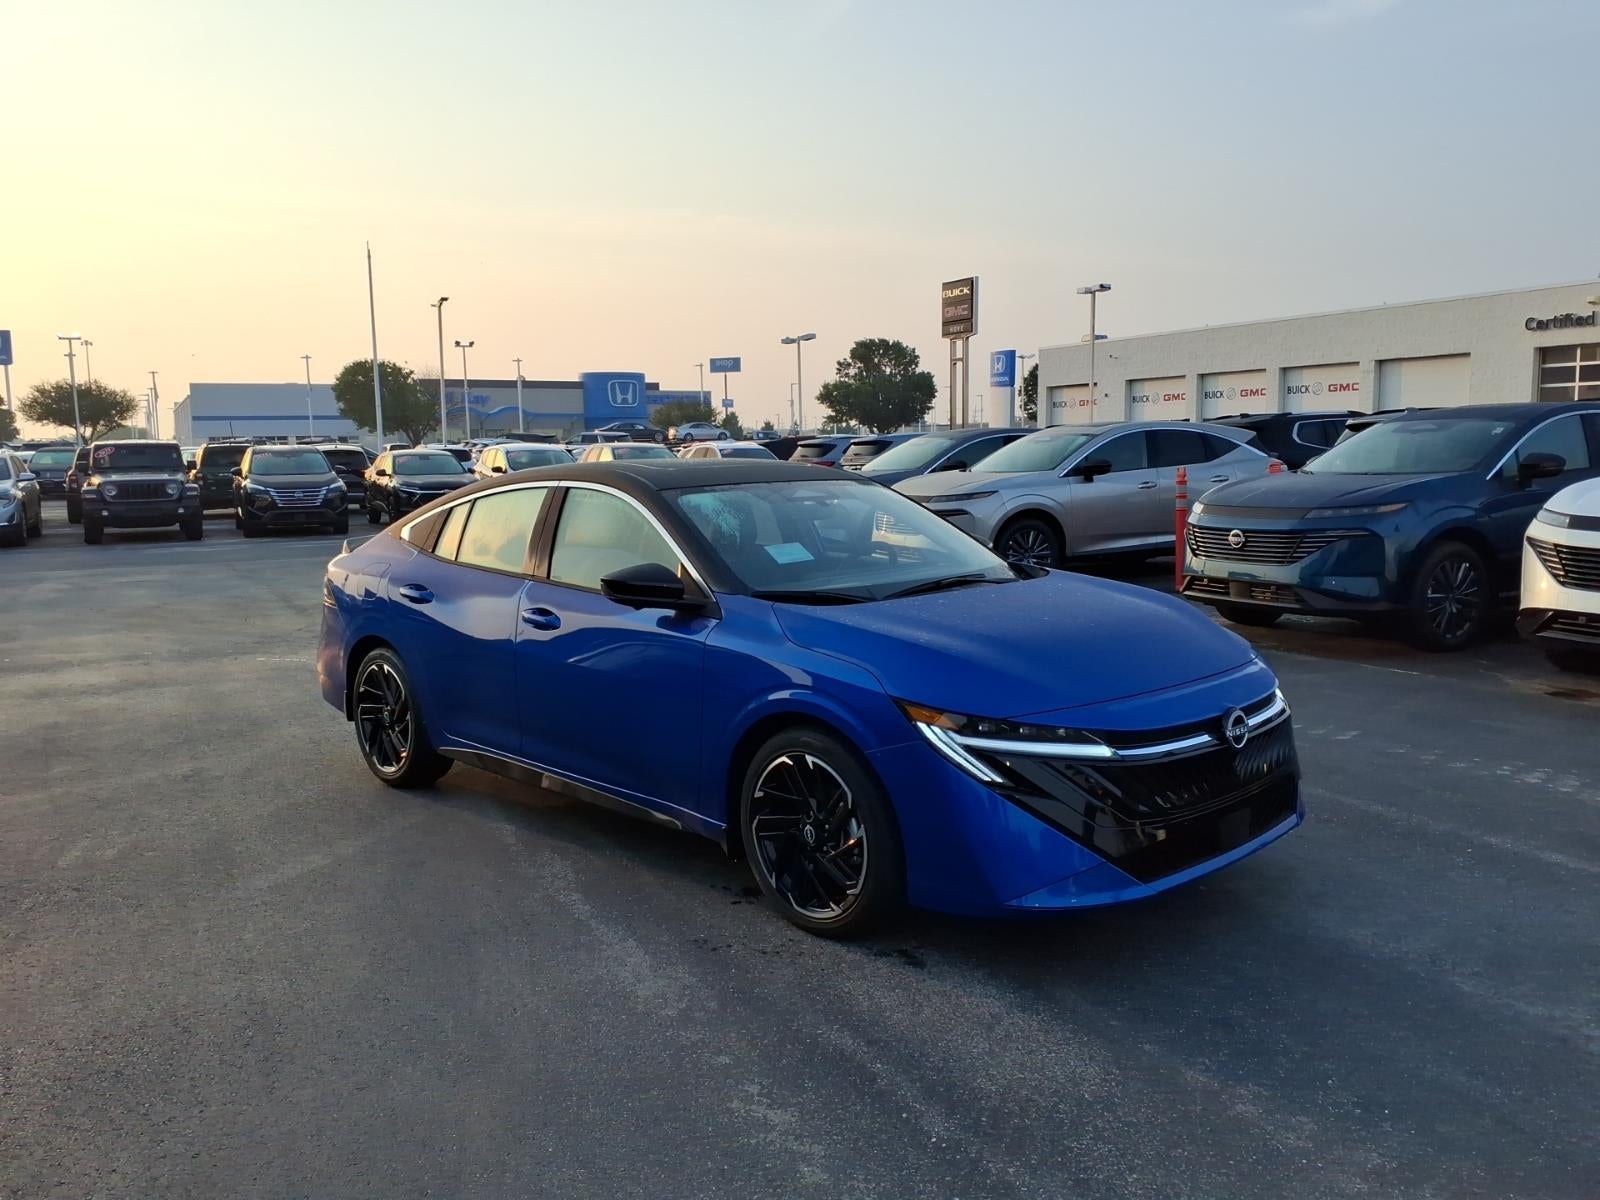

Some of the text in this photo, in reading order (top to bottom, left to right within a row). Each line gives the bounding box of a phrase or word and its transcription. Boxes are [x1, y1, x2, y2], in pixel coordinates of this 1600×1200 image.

[942, 286, 970, 298] BUICK
[944, 304, 969, 317] GMC
[1525, 310, 1596, 332] Certified
[1204, 387, 1267, 400] BUICK GMC
[1287, 382, 1360, 395] BUICK GMC
[1132, 392, 1186, 404] BUICK GMC
